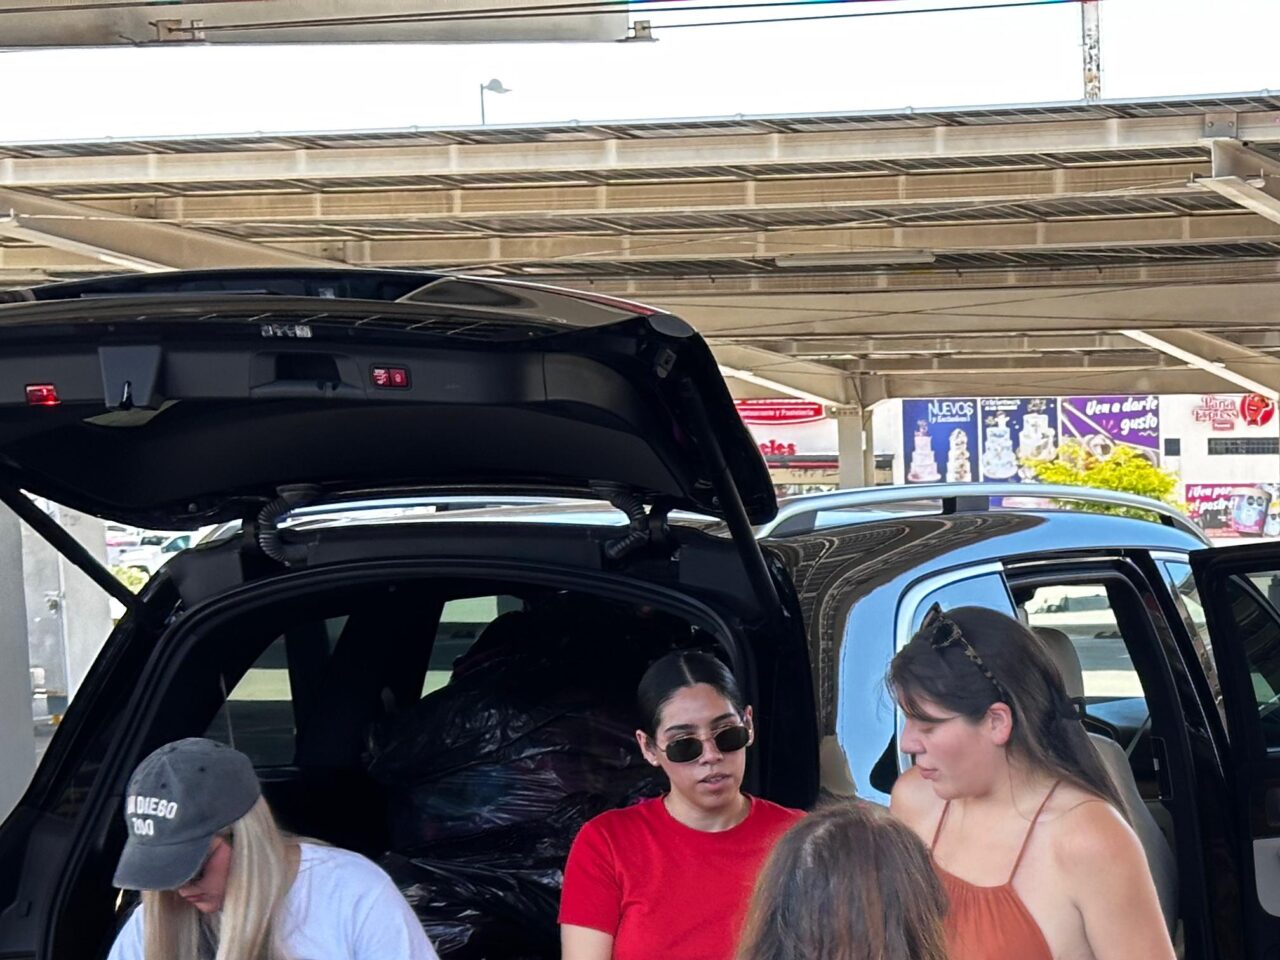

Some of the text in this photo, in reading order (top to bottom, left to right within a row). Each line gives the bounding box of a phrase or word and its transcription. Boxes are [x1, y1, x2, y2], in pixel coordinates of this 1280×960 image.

[928, 399, 974, 418] NUEVOS
[1121, 396, 1158, 412] darte
[1120, 412, 1158, 436] gusto
[137, 796, 178, 819] DIEGO
